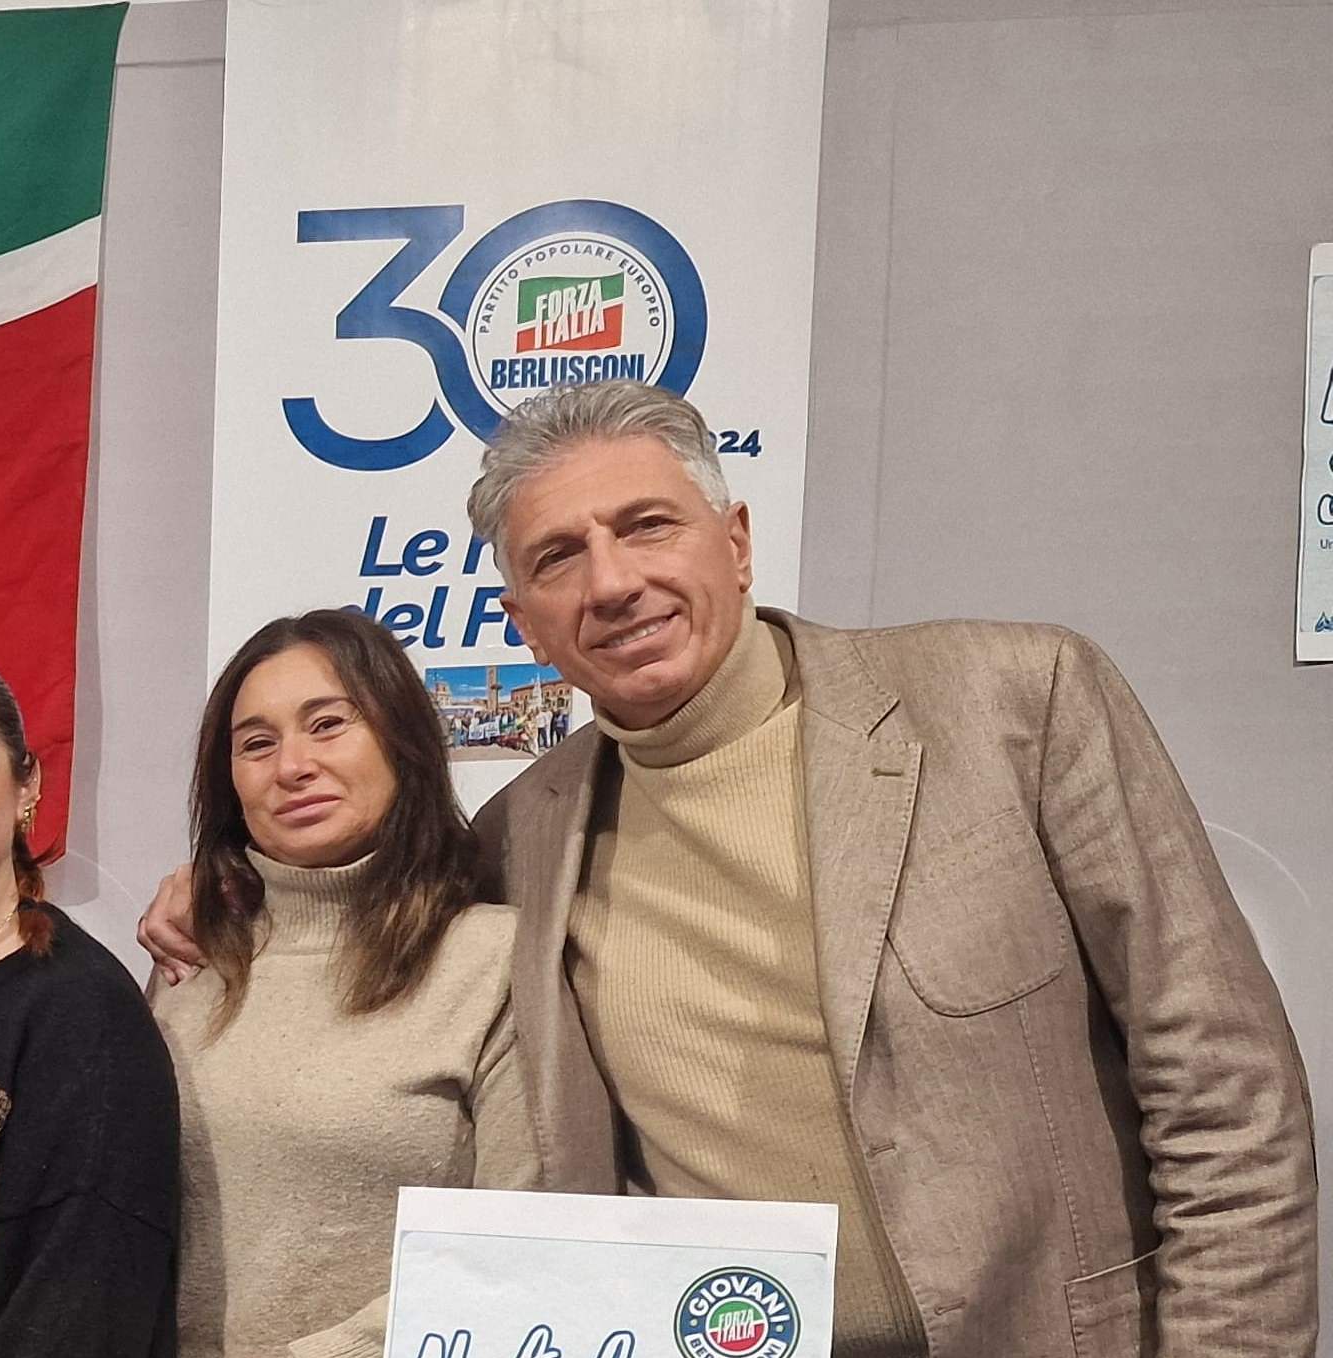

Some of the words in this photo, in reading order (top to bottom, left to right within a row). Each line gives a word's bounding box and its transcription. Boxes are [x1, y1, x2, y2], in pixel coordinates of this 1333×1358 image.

[479, 268, 518, 334] PARTITO
[524, 243, 613, 268] POPOLARE
[618, 258, 660, 328] EUROPEO
[534, 279, 602, 322] FORZA
[282, 200, 708, 472] 30
[534, 305, 606, 349] ITALIA
[490, 354, 645, 390] BERLUSCONI
[359, 516, 449, 576] Le
[689, 1276, 790, 1322] GIOVANI
